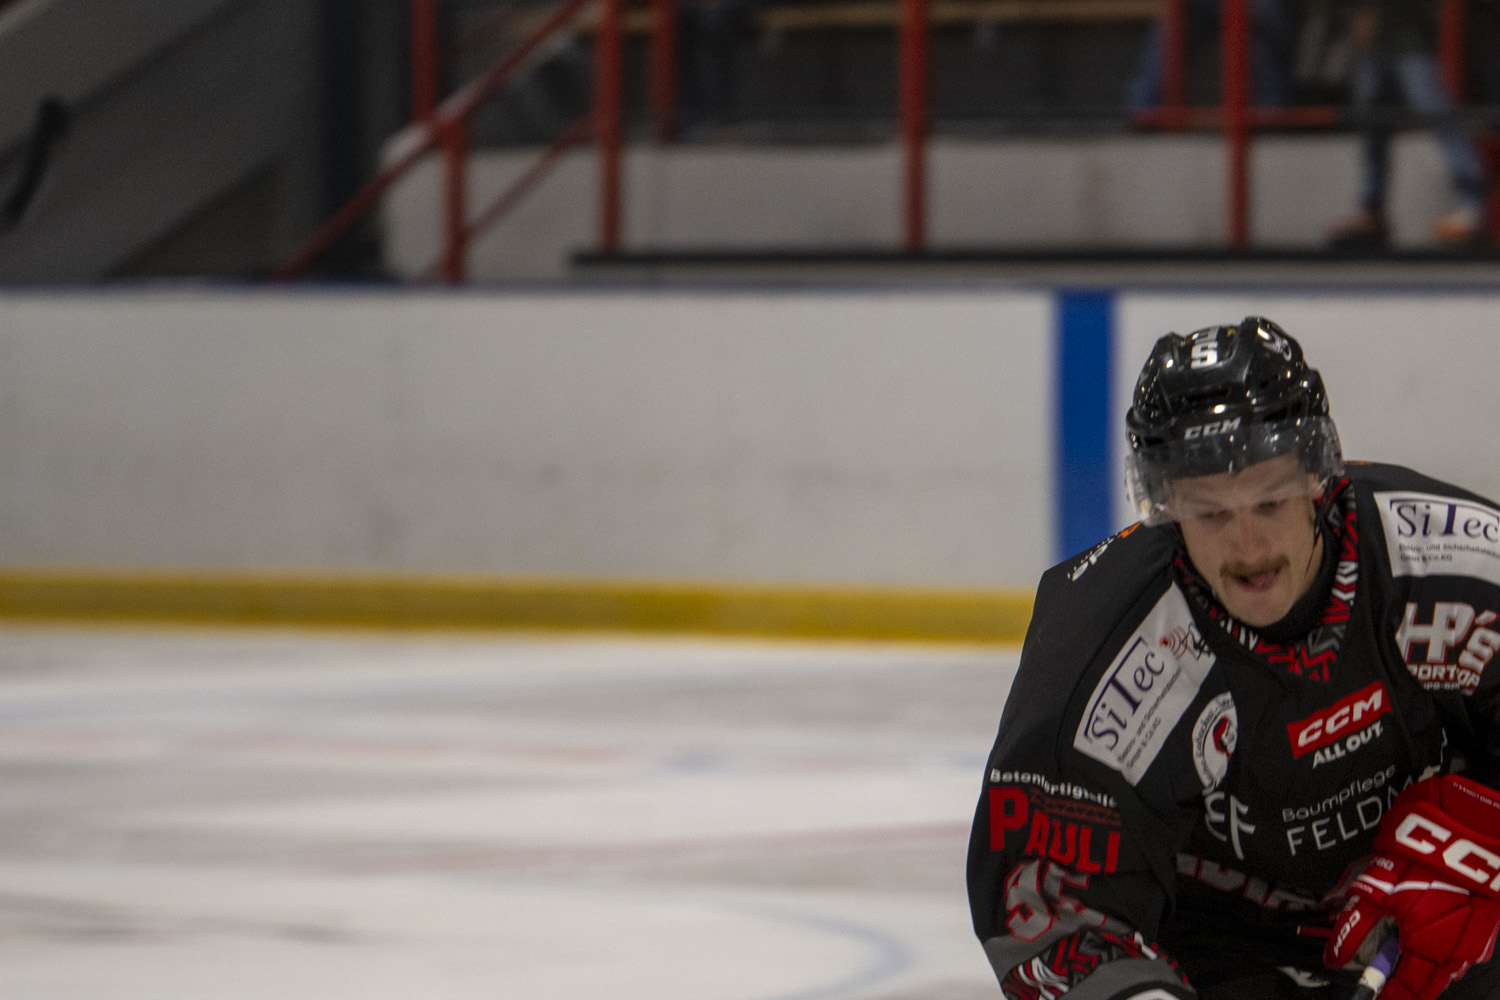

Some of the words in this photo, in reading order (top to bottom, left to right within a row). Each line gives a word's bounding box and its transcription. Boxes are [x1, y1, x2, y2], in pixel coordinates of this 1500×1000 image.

[1184, 416, 1241, 440] CCM
[1389, 498, 1500, 544] SiTec
[1084, 637, 1166, 752] SiTec
[1298, 689, 1383, 748] CCM
[1312, 741, 1349, 769] ALL
[1349, 720, 1384, 752] OUT
[1282, 765, 1396, 823] Baumpflege
[989, 787, 1121, 874] PAULI
